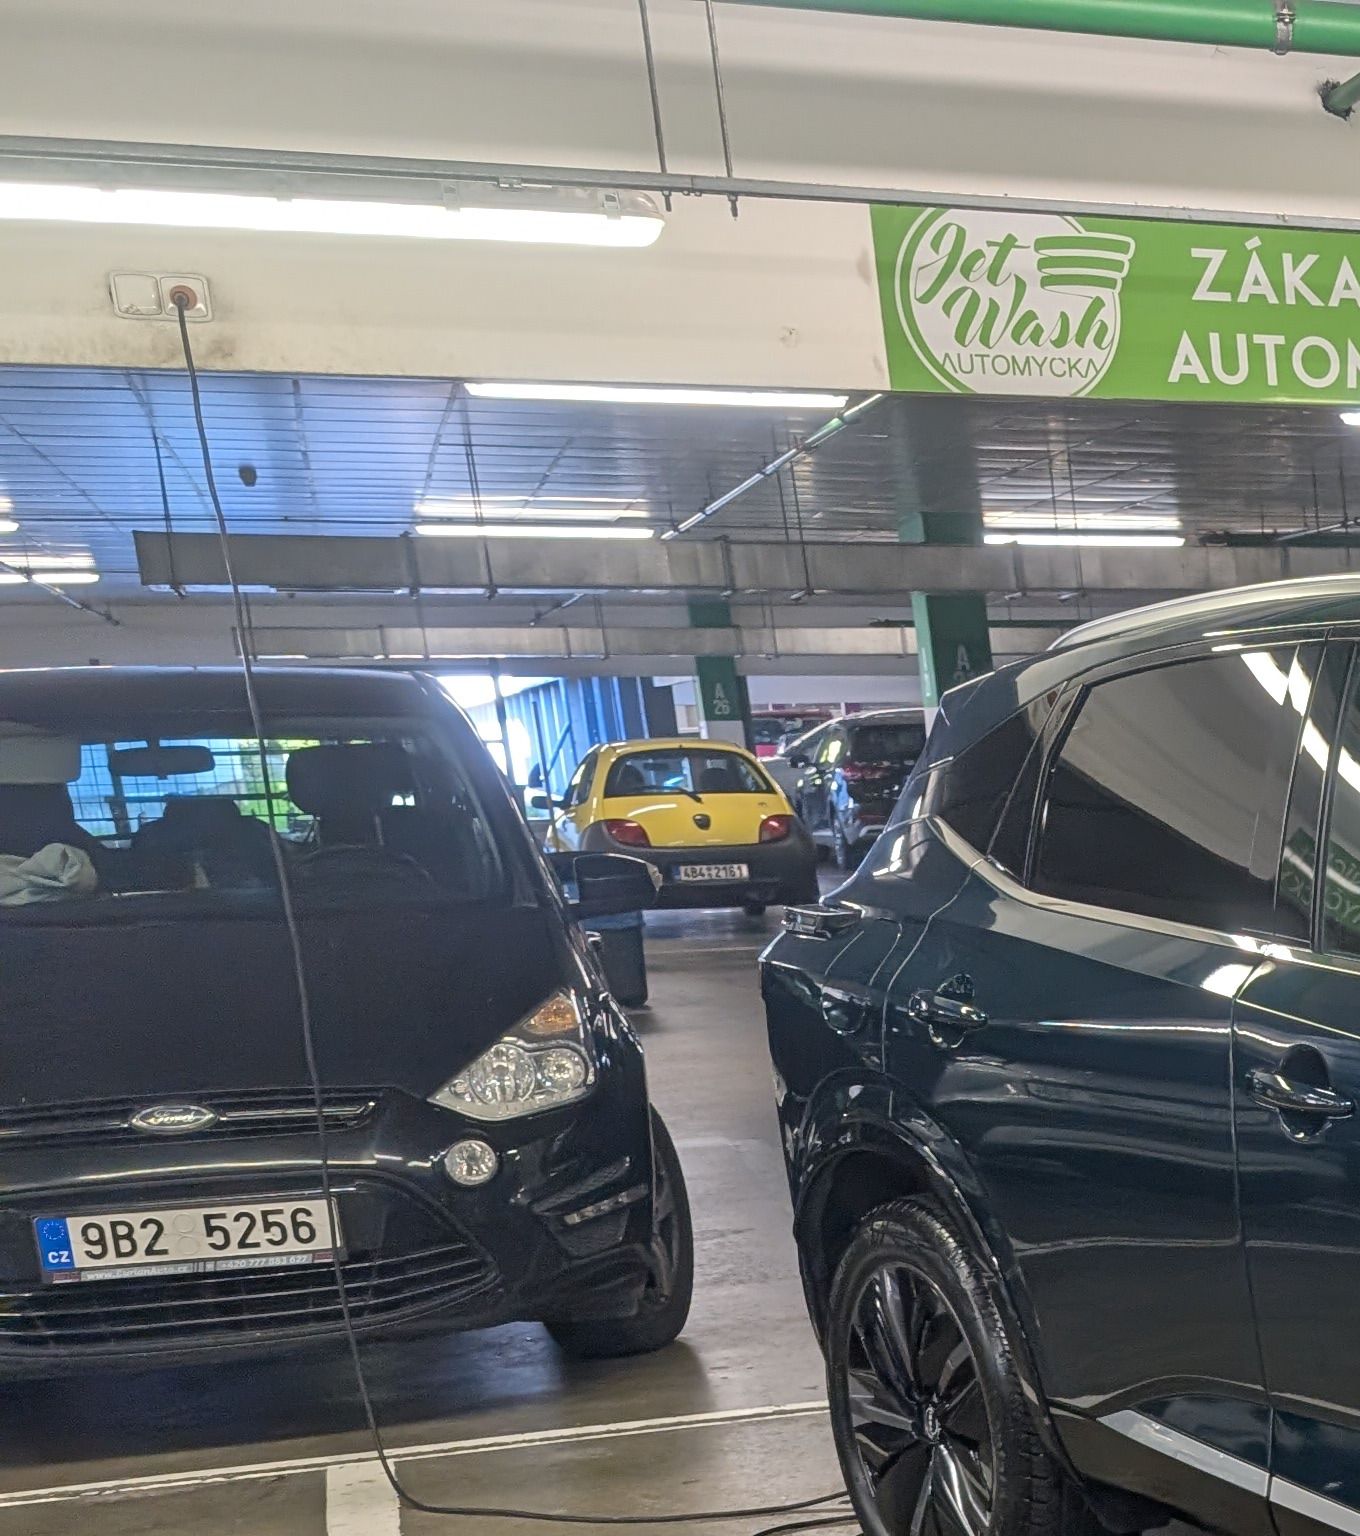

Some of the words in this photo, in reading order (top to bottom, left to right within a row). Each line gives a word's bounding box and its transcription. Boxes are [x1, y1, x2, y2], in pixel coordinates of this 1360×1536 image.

[914, 222, 1030, 304] Jet
[942, 273, 1113, 350] Wash
[148, 1107, 199, 1124] Ford
[48, 1251, 70, 1264] CZ
[80, 1217, 168, 1260] 9B2
[203, 1207, 316, 1250] 5256
